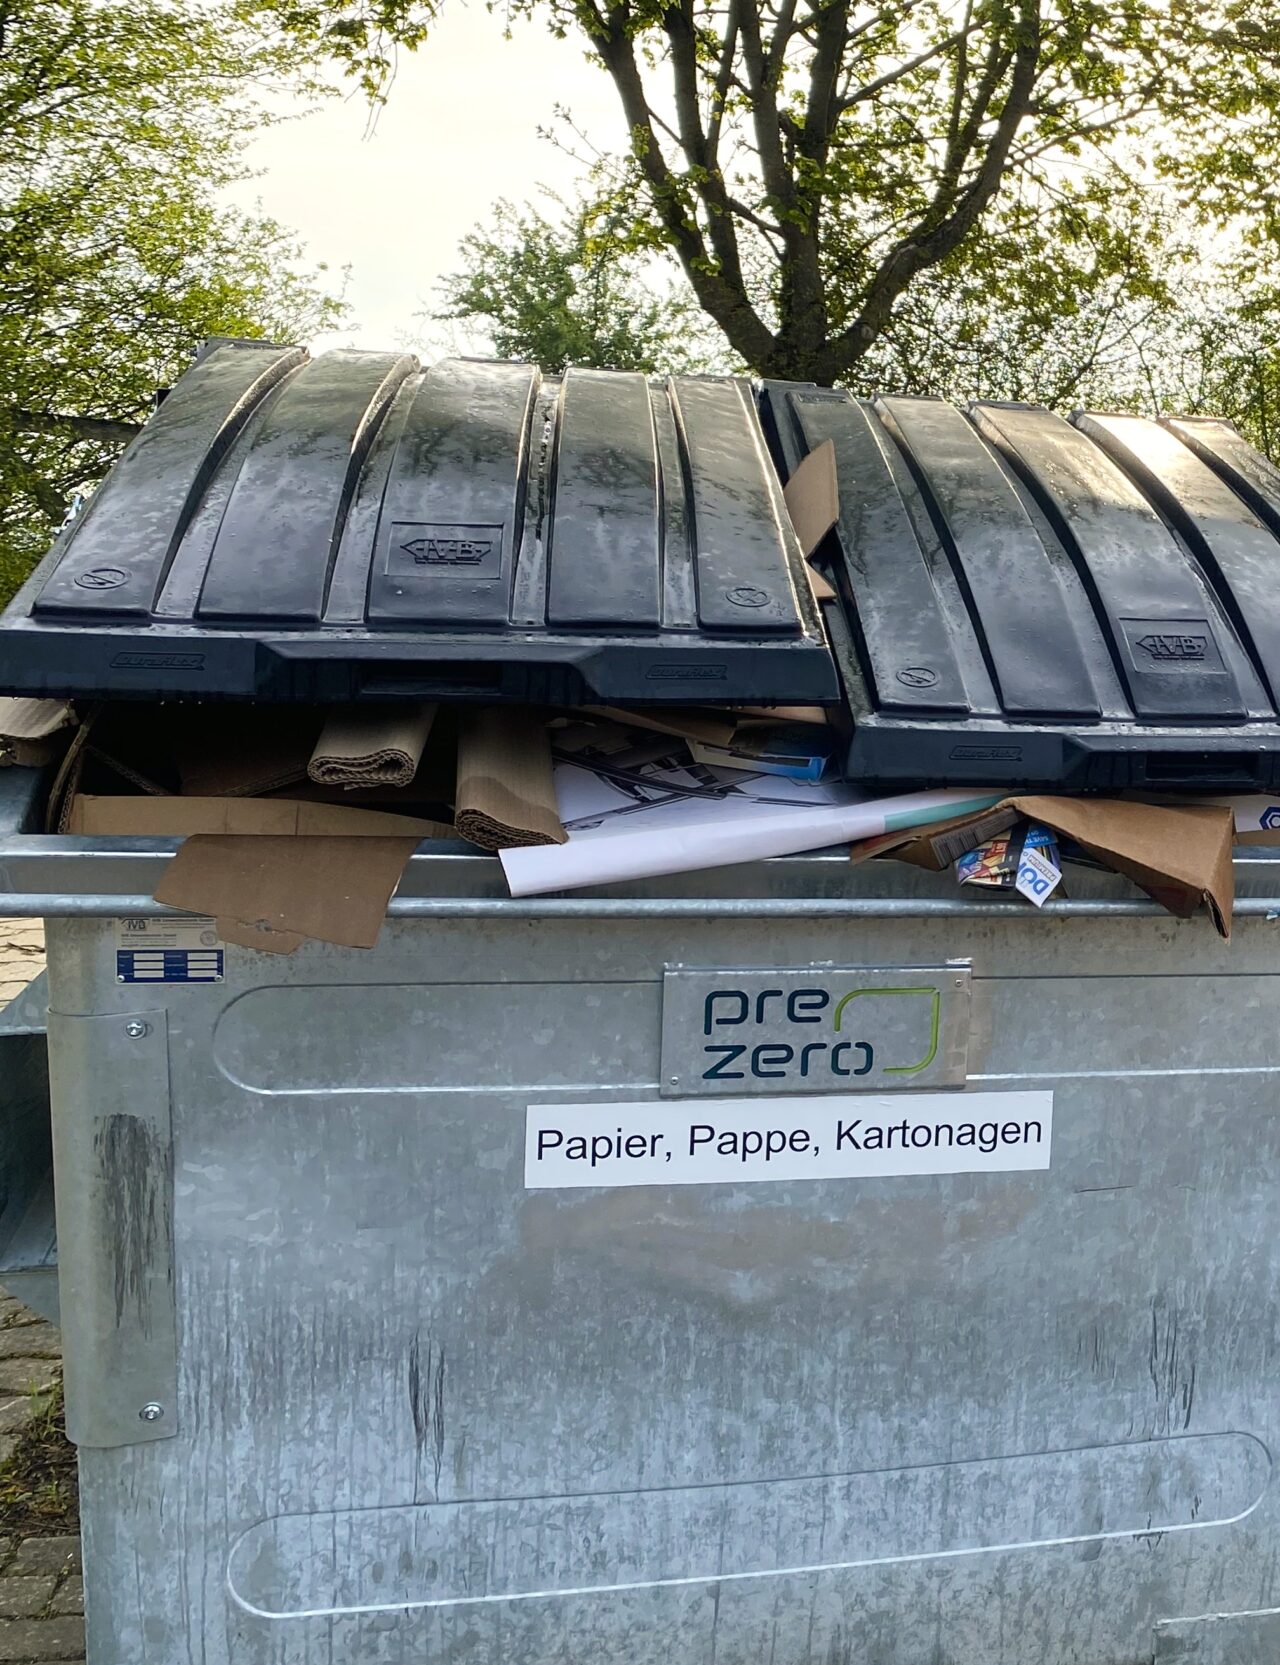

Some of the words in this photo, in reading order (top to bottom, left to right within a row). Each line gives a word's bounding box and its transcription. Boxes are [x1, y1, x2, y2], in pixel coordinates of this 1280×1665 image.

[704, 988, 830, 1036] pre
[701, 1041, 874, 1080] zero
[537, 1127, 673, 1168] Papier,
[689, 1124, 820, 1163] Pappe,
[836, 1119, 1042, 1153] Kartonagen
